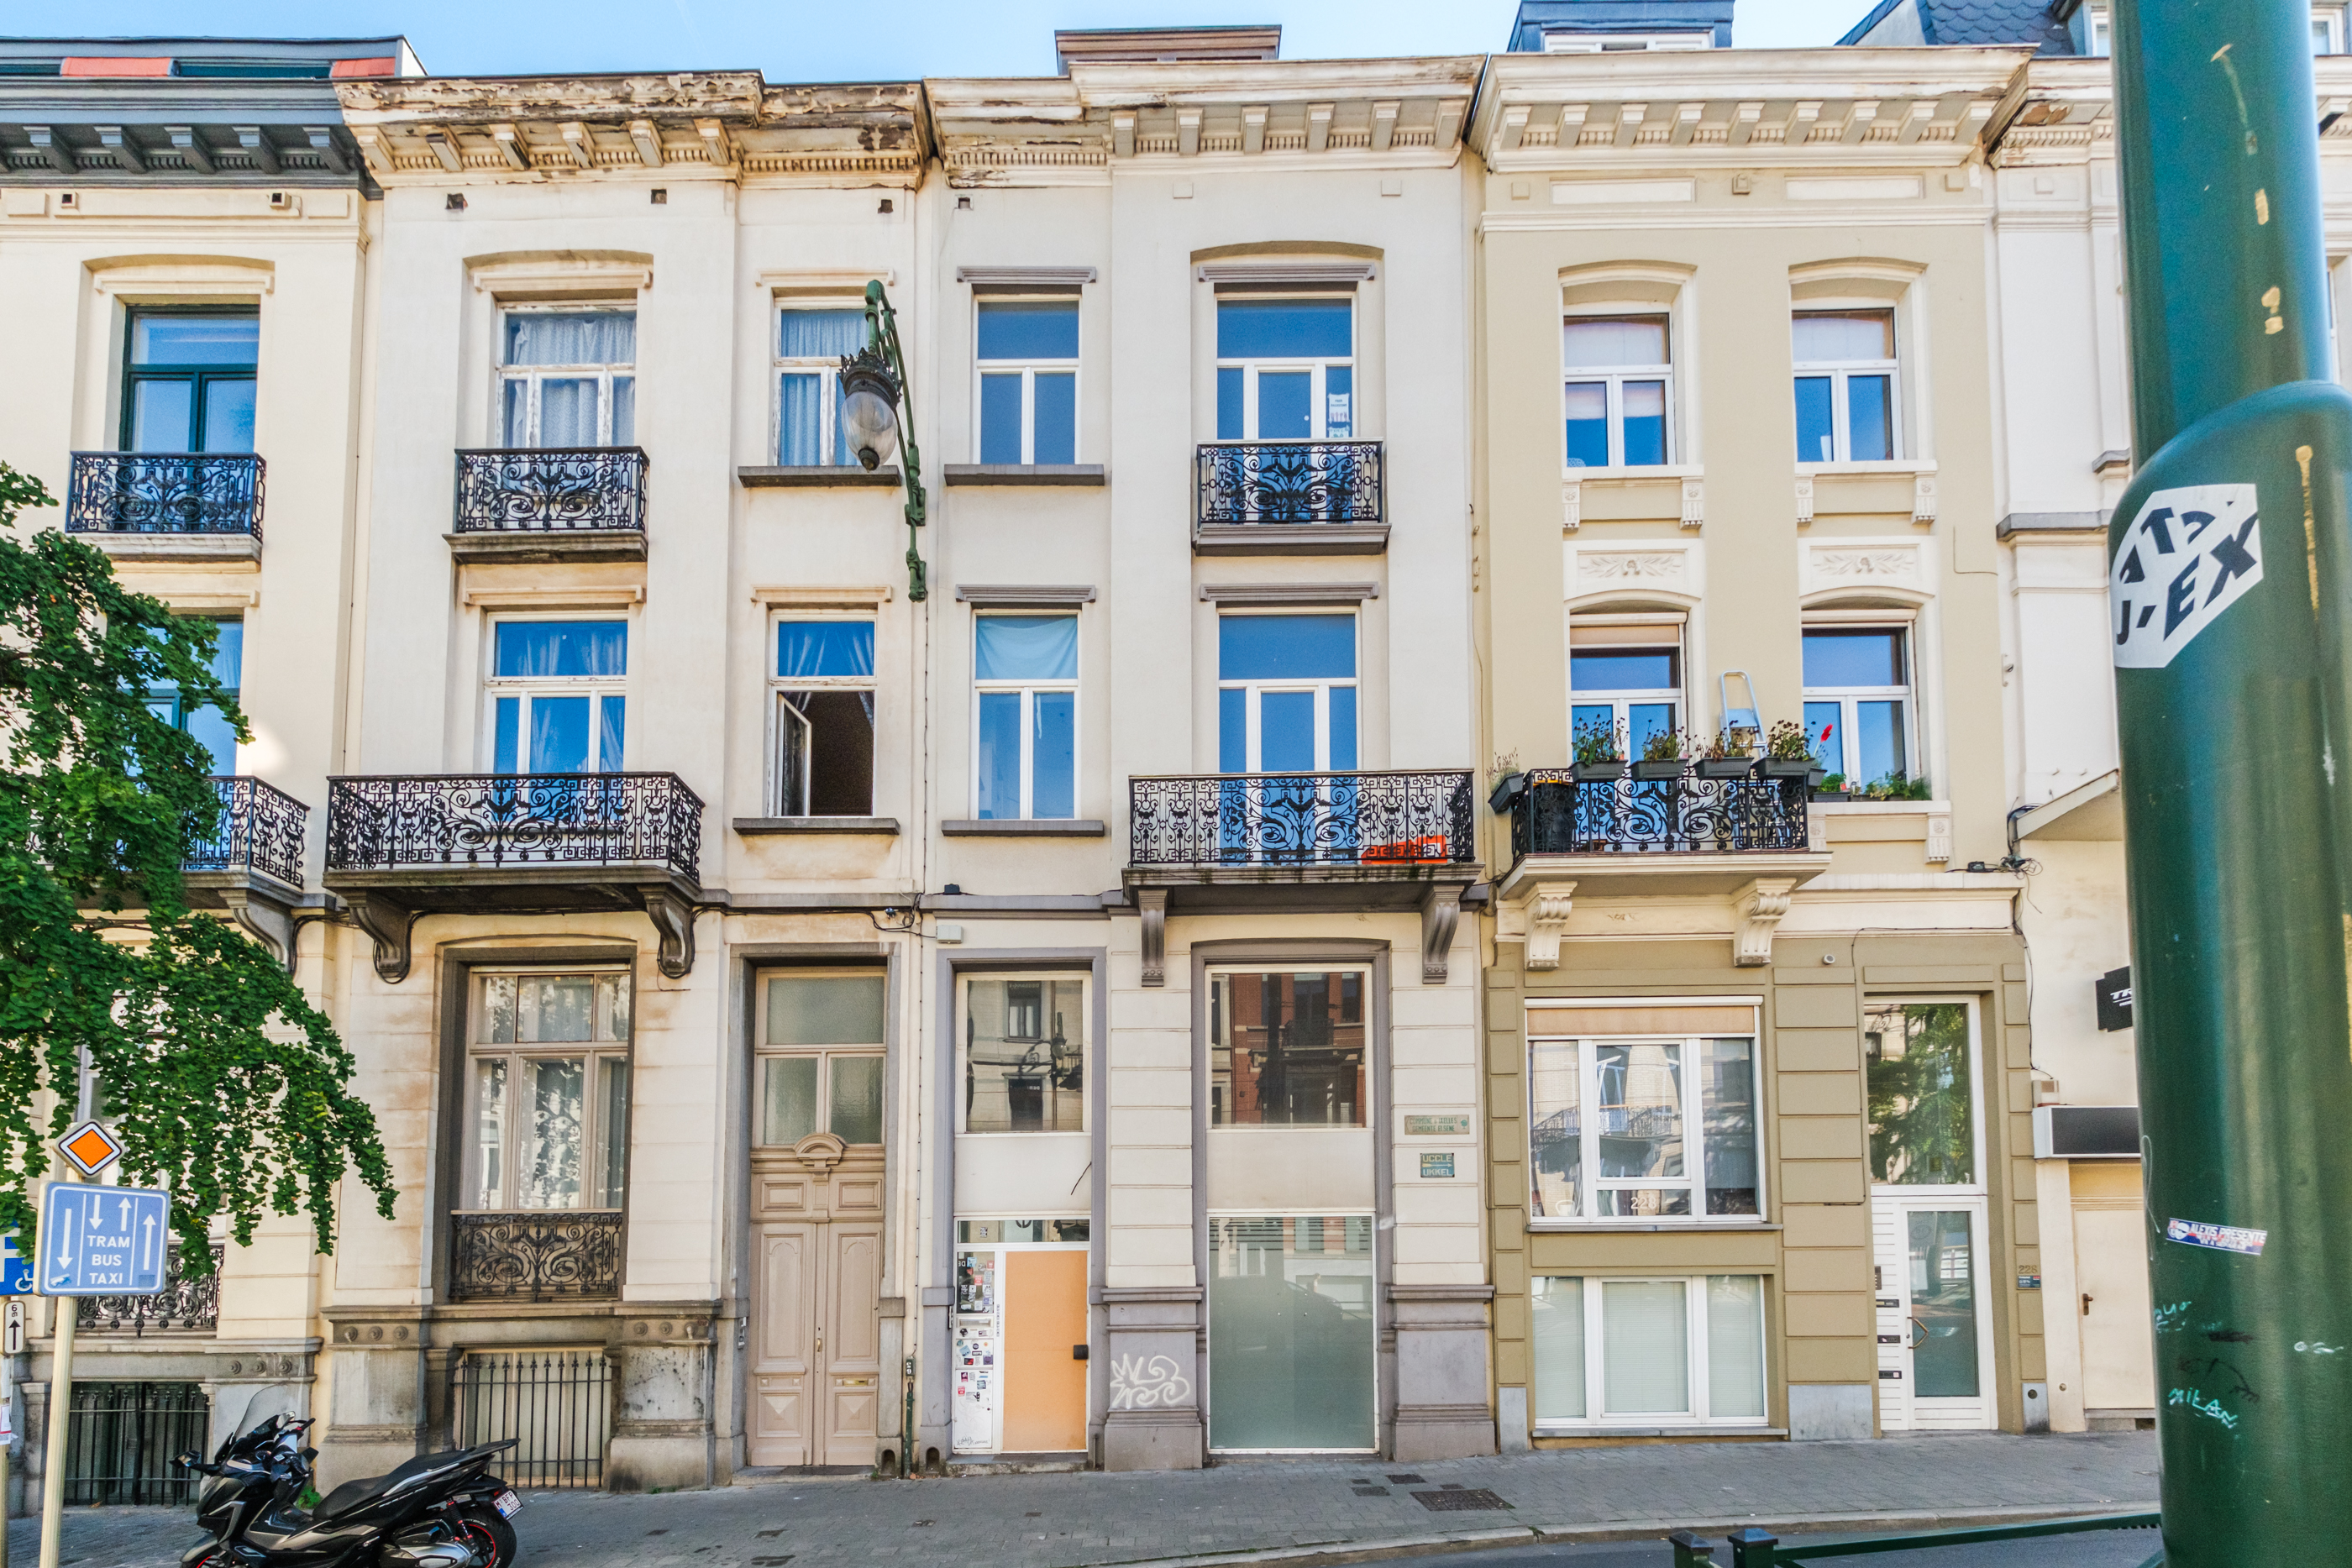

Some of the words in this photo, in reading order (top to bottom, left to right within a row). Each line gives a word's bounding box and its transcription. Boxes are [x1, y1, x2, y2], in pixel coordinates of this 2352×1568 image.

[1630, 1197, 1656, 1209] 228
[2190, 1223, 2218, 1237] ALEXIS
[87, 1235, 130, 1248] TRAM
[92, 1254, 122, 1266] BUS
[2019, 1265, 2038, 1274] 228
[89, 1272, 123, 1284] TAXI
[507, 1499, 520, 1511] 300
